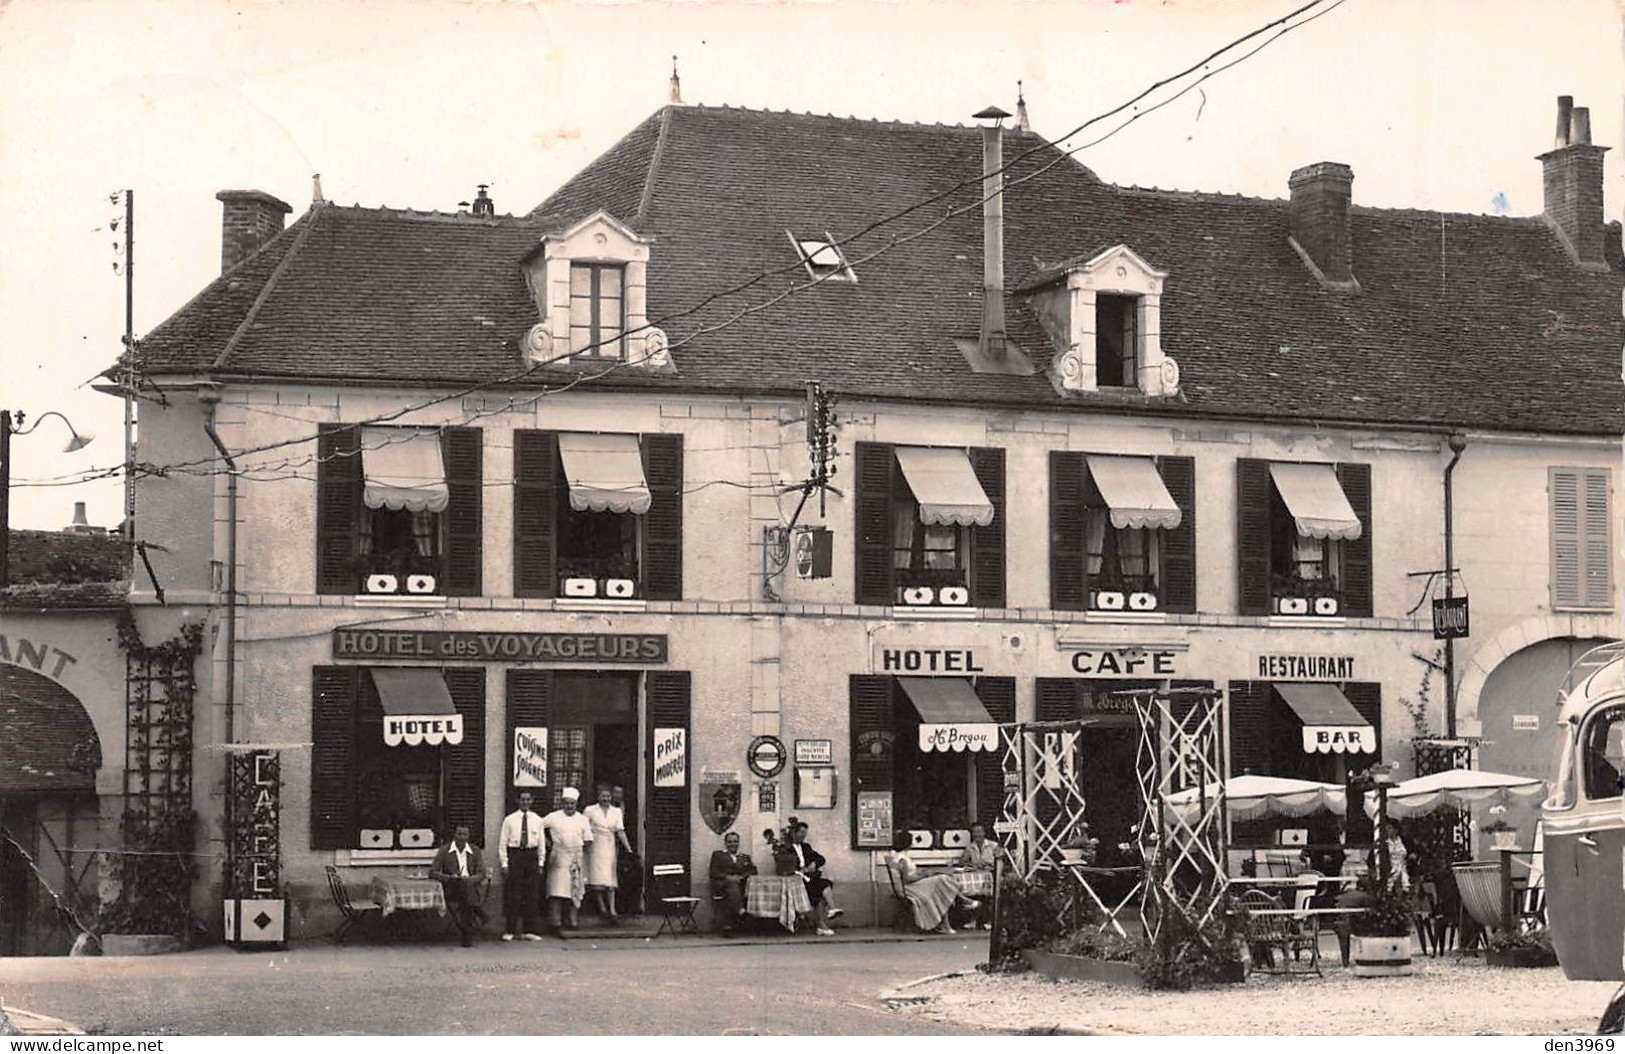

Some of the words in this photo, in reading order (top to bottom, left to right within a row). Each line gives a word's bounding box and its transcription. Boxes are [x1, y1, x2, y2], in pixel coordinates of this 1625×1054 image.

[440, 636, 478, 655] des
[478, 635, 660, 658] VOYAGEURS
[883, 650, 983, 672] HOTEL
[1259, 656, 1354, 678] RESTAURANT
[390, 720, 457, 735] HOTEL
[1316, 731, 1361, 744] BAR
